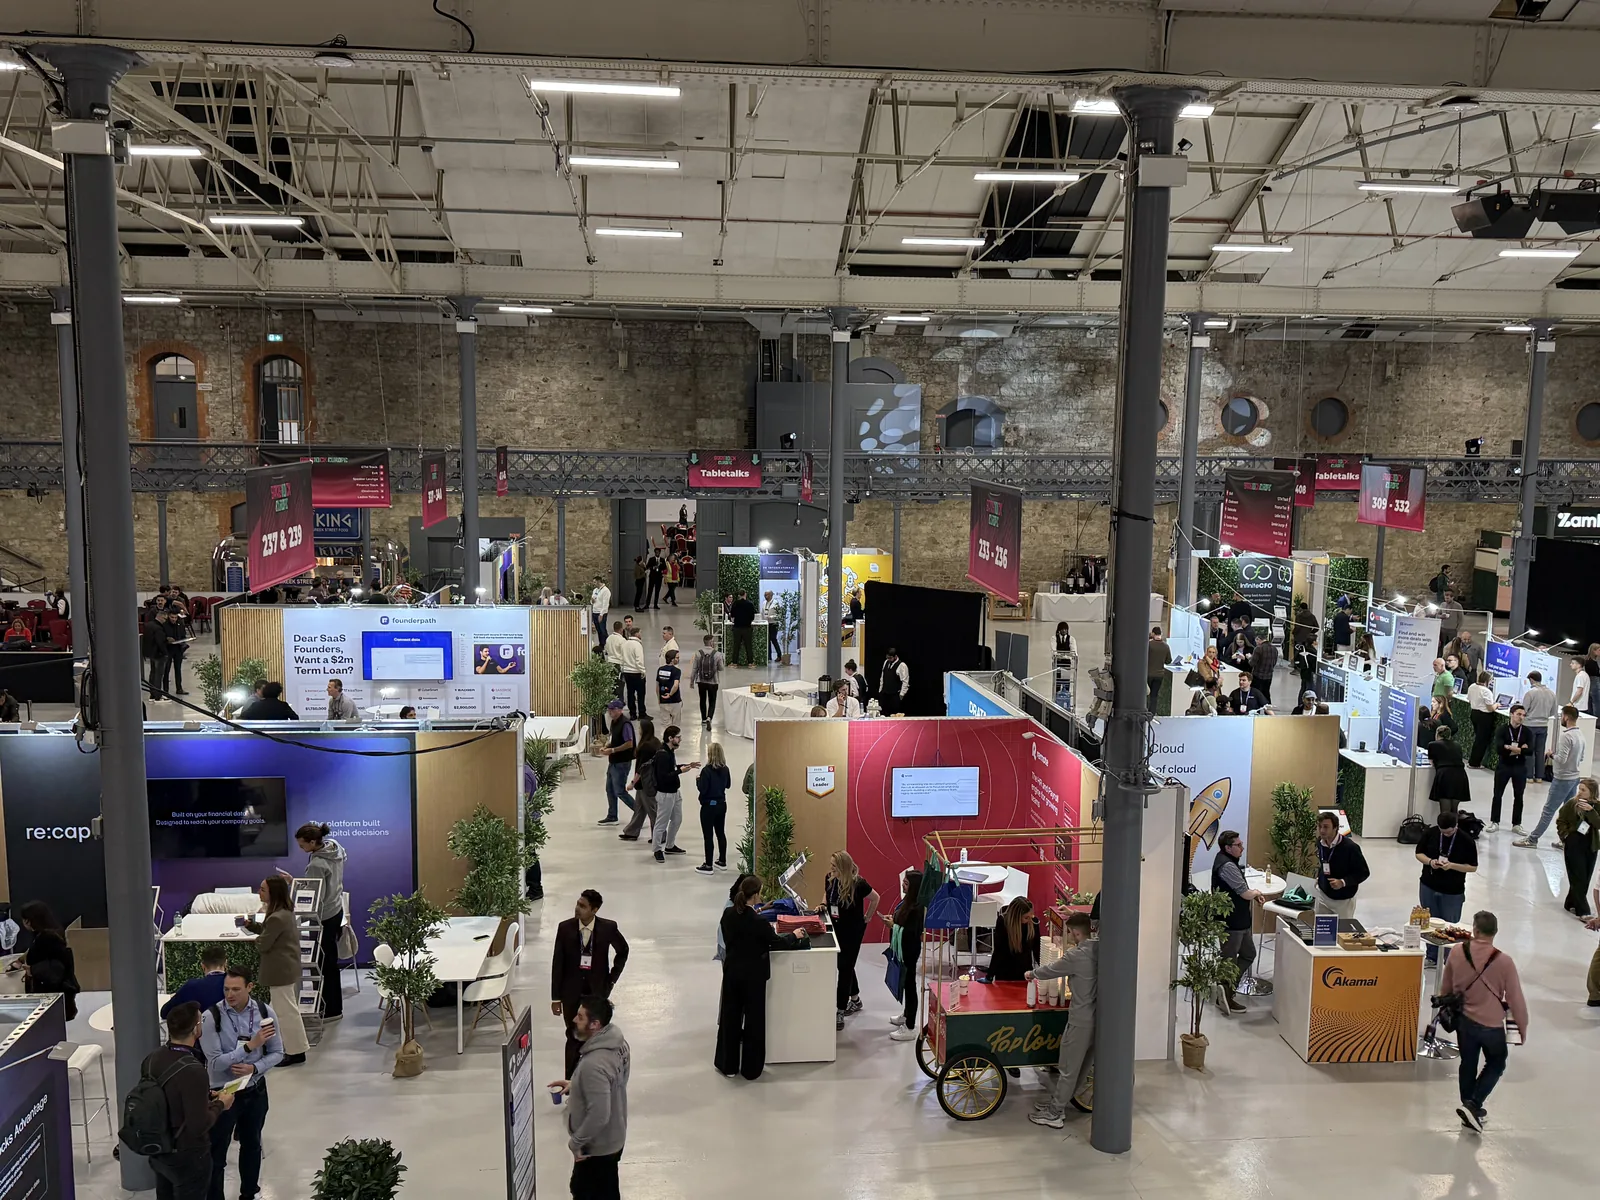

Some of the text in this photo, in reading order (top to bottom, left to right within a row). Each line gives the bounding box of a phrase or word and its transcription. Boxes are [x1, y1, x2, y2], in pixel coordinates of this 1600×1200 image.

[700, 469, 750, 478] Tabletalks
[1371, 496, 1388, 510] 309
[1394, 499, 1410, 513] 332
[316, 513, 352, 528] KING
[262, 524, 303, 557] 237 & 239
[978, 538, 990, 561] 233
[994, 545, 1008, 569] 236
[392, 616, 437, 625] founderpath
[293, 634, 346, 643] Dear SaaS
[293, 645, 344, 654] Founders,
[294, 656, 321, 664] Want
[330, 655, 354, 665] $2m
[295, 666, 354, 675] Term Loan?
[1151, 743, 1185, 754] Cloud
[1036, 751, 1049, 767] remote
[1155, 764, 1197, 774] of cloud
[326, 819, 361, 828] platform
[362, 819, 380, 827] built
[25, 826, 91, 843] re:cap
[326, 829, 350, 838] apital
[1332, 976, 1379, 987] Akamai
[14, 1094, 48, 1139] Advantage
